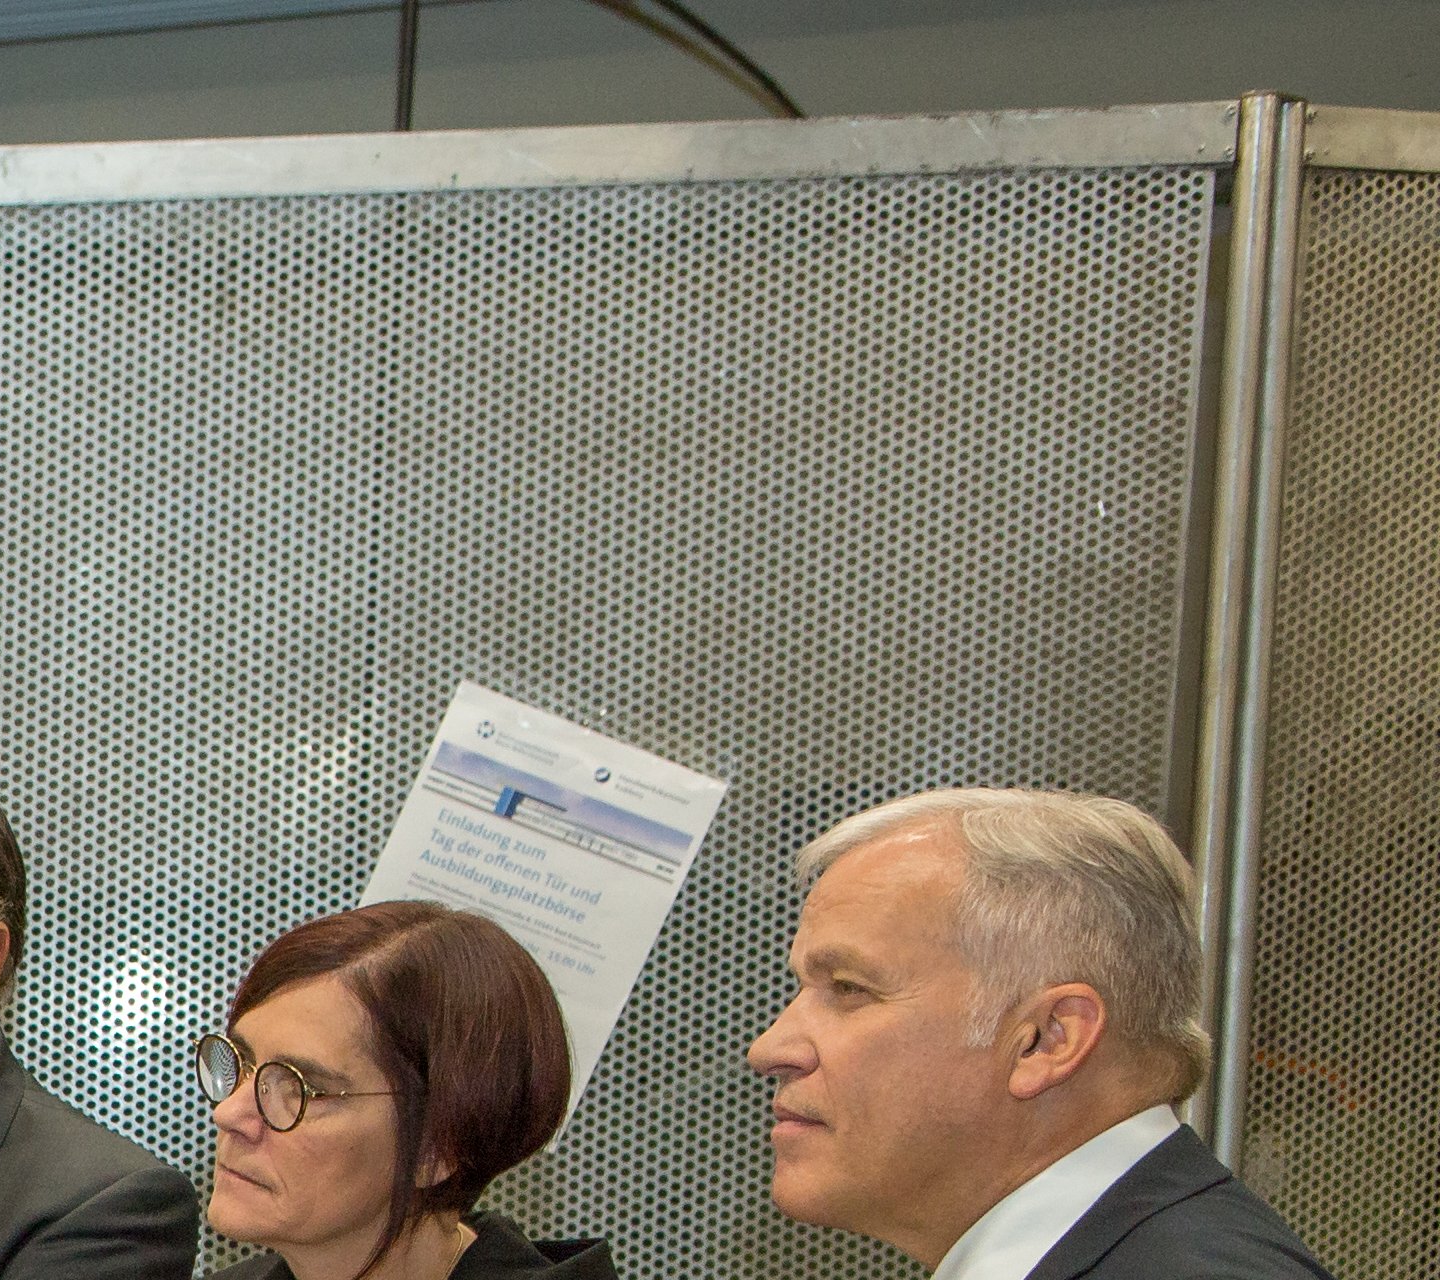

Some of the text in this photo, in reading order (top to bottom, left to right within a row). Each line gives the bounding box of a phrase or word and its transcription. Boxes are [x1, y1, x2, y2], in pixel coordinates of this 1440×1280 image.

[426, 827, 602, 906] Tag der offenen Tür und
[436, 807, 547, 863] Einladung zum
[417, 846, 587, 926] Ausbildungsplatzbörse
